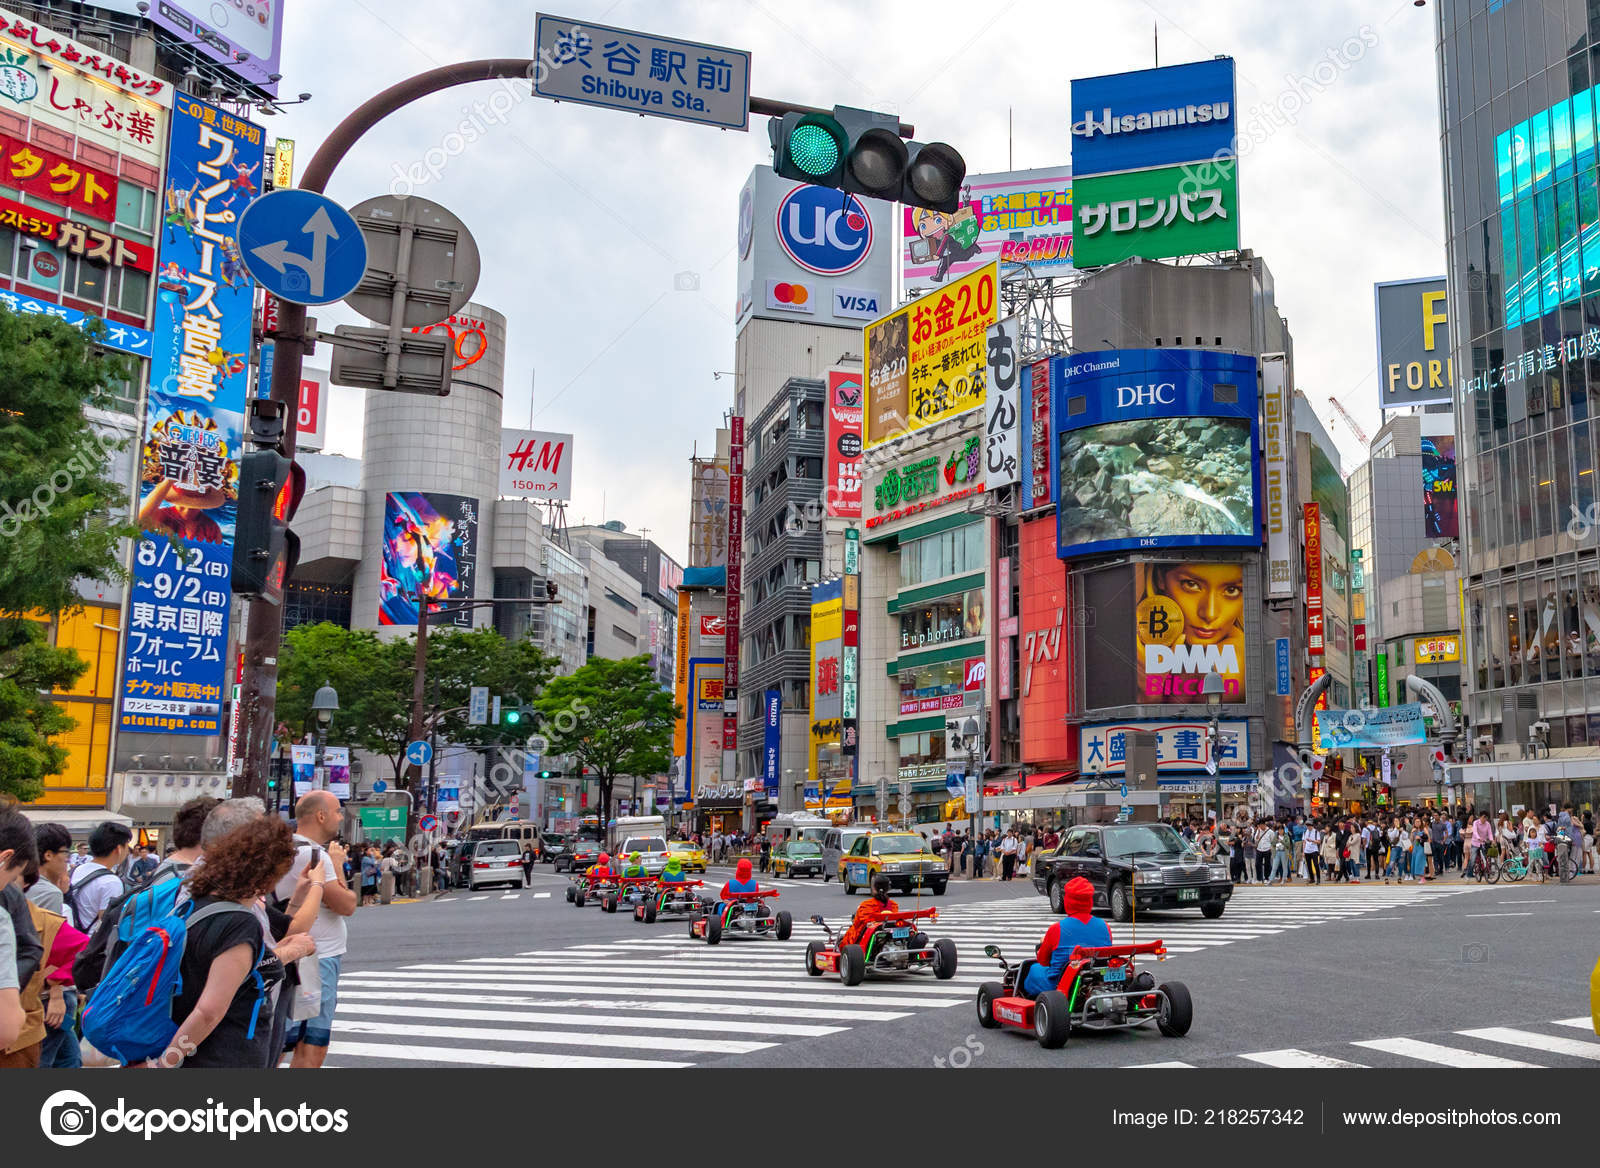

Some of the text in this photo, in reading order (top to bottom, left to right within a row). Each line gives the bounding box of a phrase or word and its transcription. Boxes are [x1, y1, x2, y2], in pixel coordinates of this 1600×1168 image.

[553, 29, 732, 94] 渋谷駅前
[581, 74, 711, 113] Shibuya Sta.
[50, 76, 156, 145] しゃぶ葉
[176, 96, 262, 146] この夏、世界初
[1070, 101, 1229, 138] Hisamitsu
[1078, 188, 1227, 236] サロンパス
[57, 221, 138, 268] ガスト
[36, 260, 57, 272] ガスト
[836, 294, 878, 313] VISA
[911, 273, 993, 346] お金2.0
[870, 356, 907, 388] お金2.0
[1064, 357, 1121, 378] DHC Channel
[1388, 359, 1453, 393] FOR
[986, 319, 1017, 480] もんじゃ
[1117, 383, 1176, 409] DHC
[508, 438, 565, 475] H&M
[1265, 385, 1284, 535] Taisei neon
[512, 479, 546, 492] 150m
[1140, 538, 1158, 547] DHC
[1306, 506, 1320, 590] クスリのことなら
[131, 602, 224, 637] 東京国際
[1308, 596, 1324, 648] 三千里
[130, 631, 221, 662] フォーラム
[902, 624, 962, 648] Euphoria
[127, 656, 183, 677] ホールC
[966, 661, 986, 687] JTB
[1145, 644, 1240, 674] DMM
[126, 679, 221, 701] チケット販売中!
[1145, 674, 1240, 696] Bitcn
[122, 714, 217, 730] otoutage.com
[770, 697, 778, 727] MIZUHO
